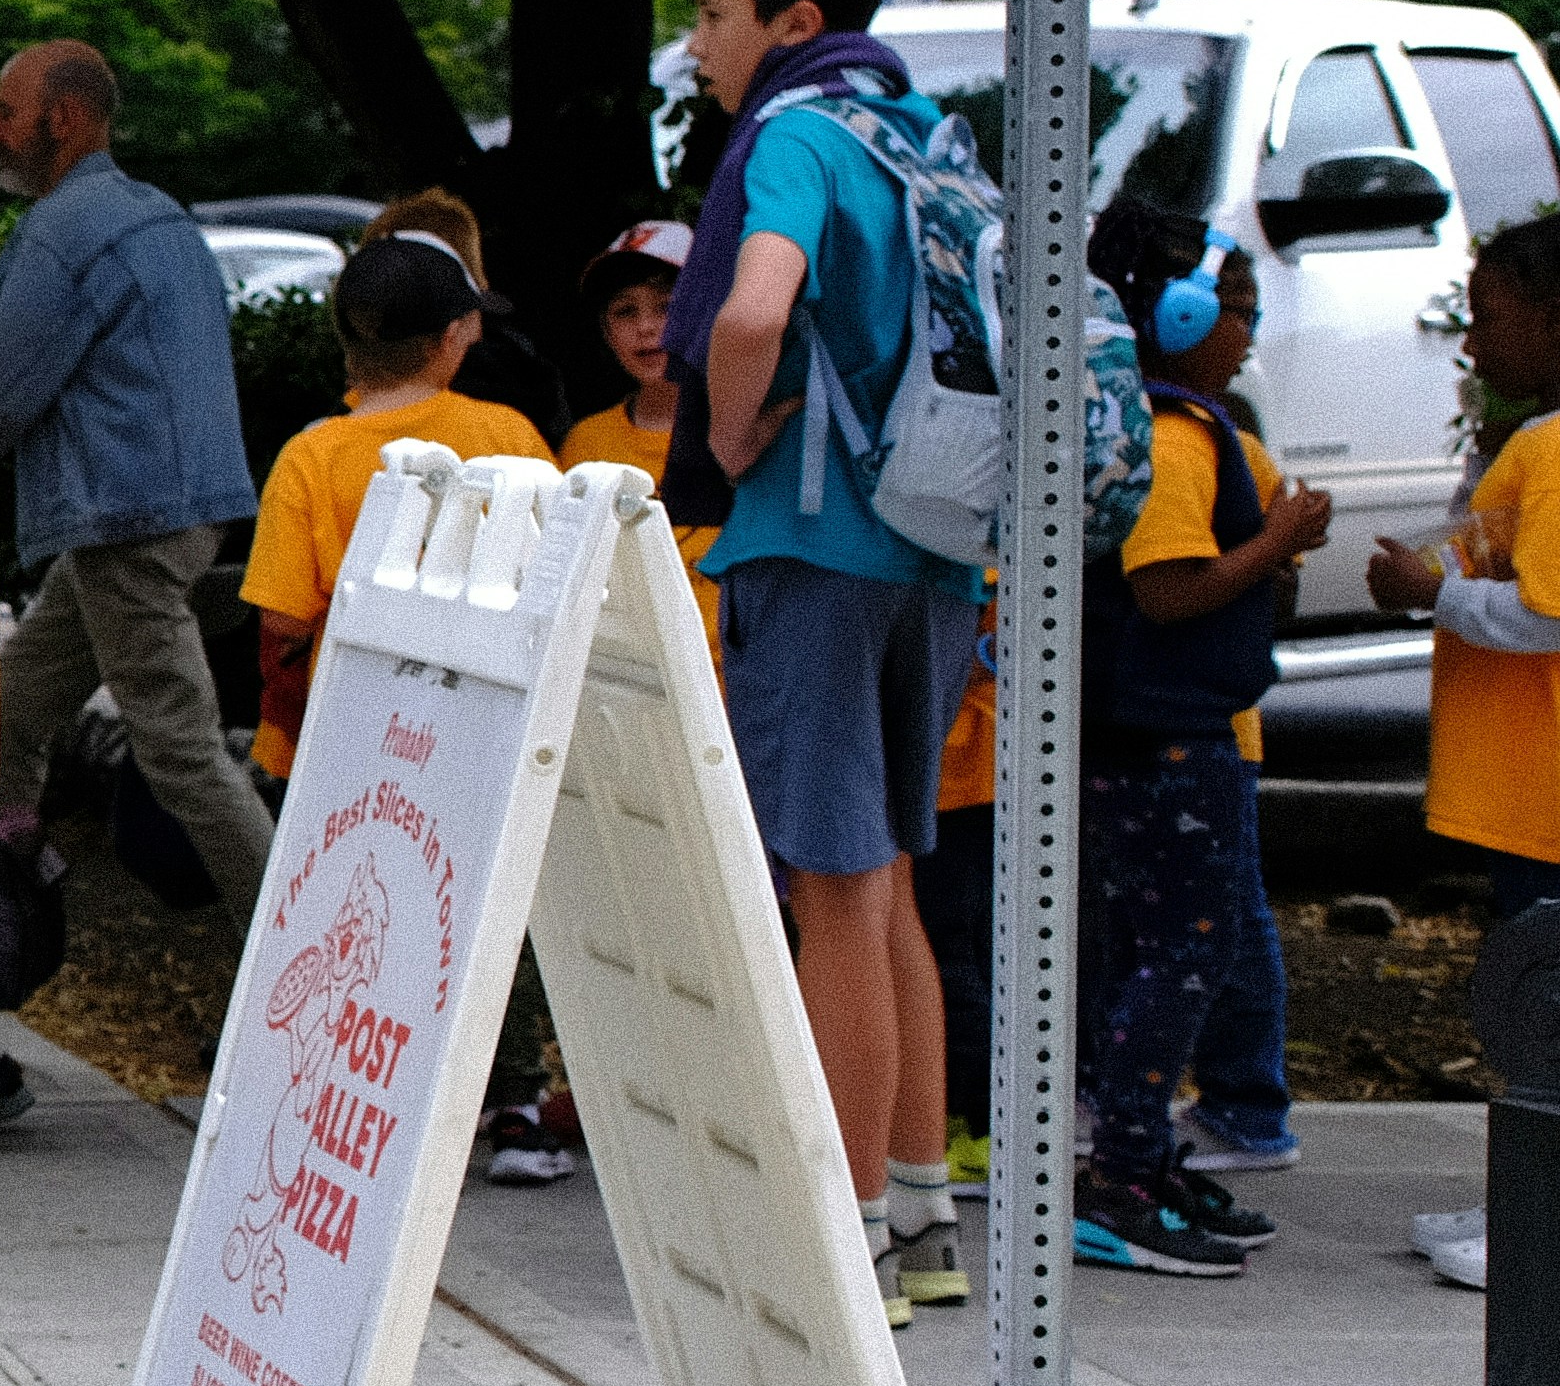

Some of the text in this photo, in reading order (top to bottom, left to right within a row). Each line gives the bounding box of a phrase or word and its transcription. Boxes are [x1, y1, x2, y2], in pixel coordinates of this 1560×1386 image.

[380, 711, 437, 773] Probably
[273, 779, 455, 1015] The Best Slices in Town
[331, 999, 413, 1090] POST
[312, 1082, 399, 1180] ALLEY
[280, 1163, 360, 1265] PIZZA
[197, 1310, 230, 1359] BEER
[228, 1334, 263, 1385] WINE
